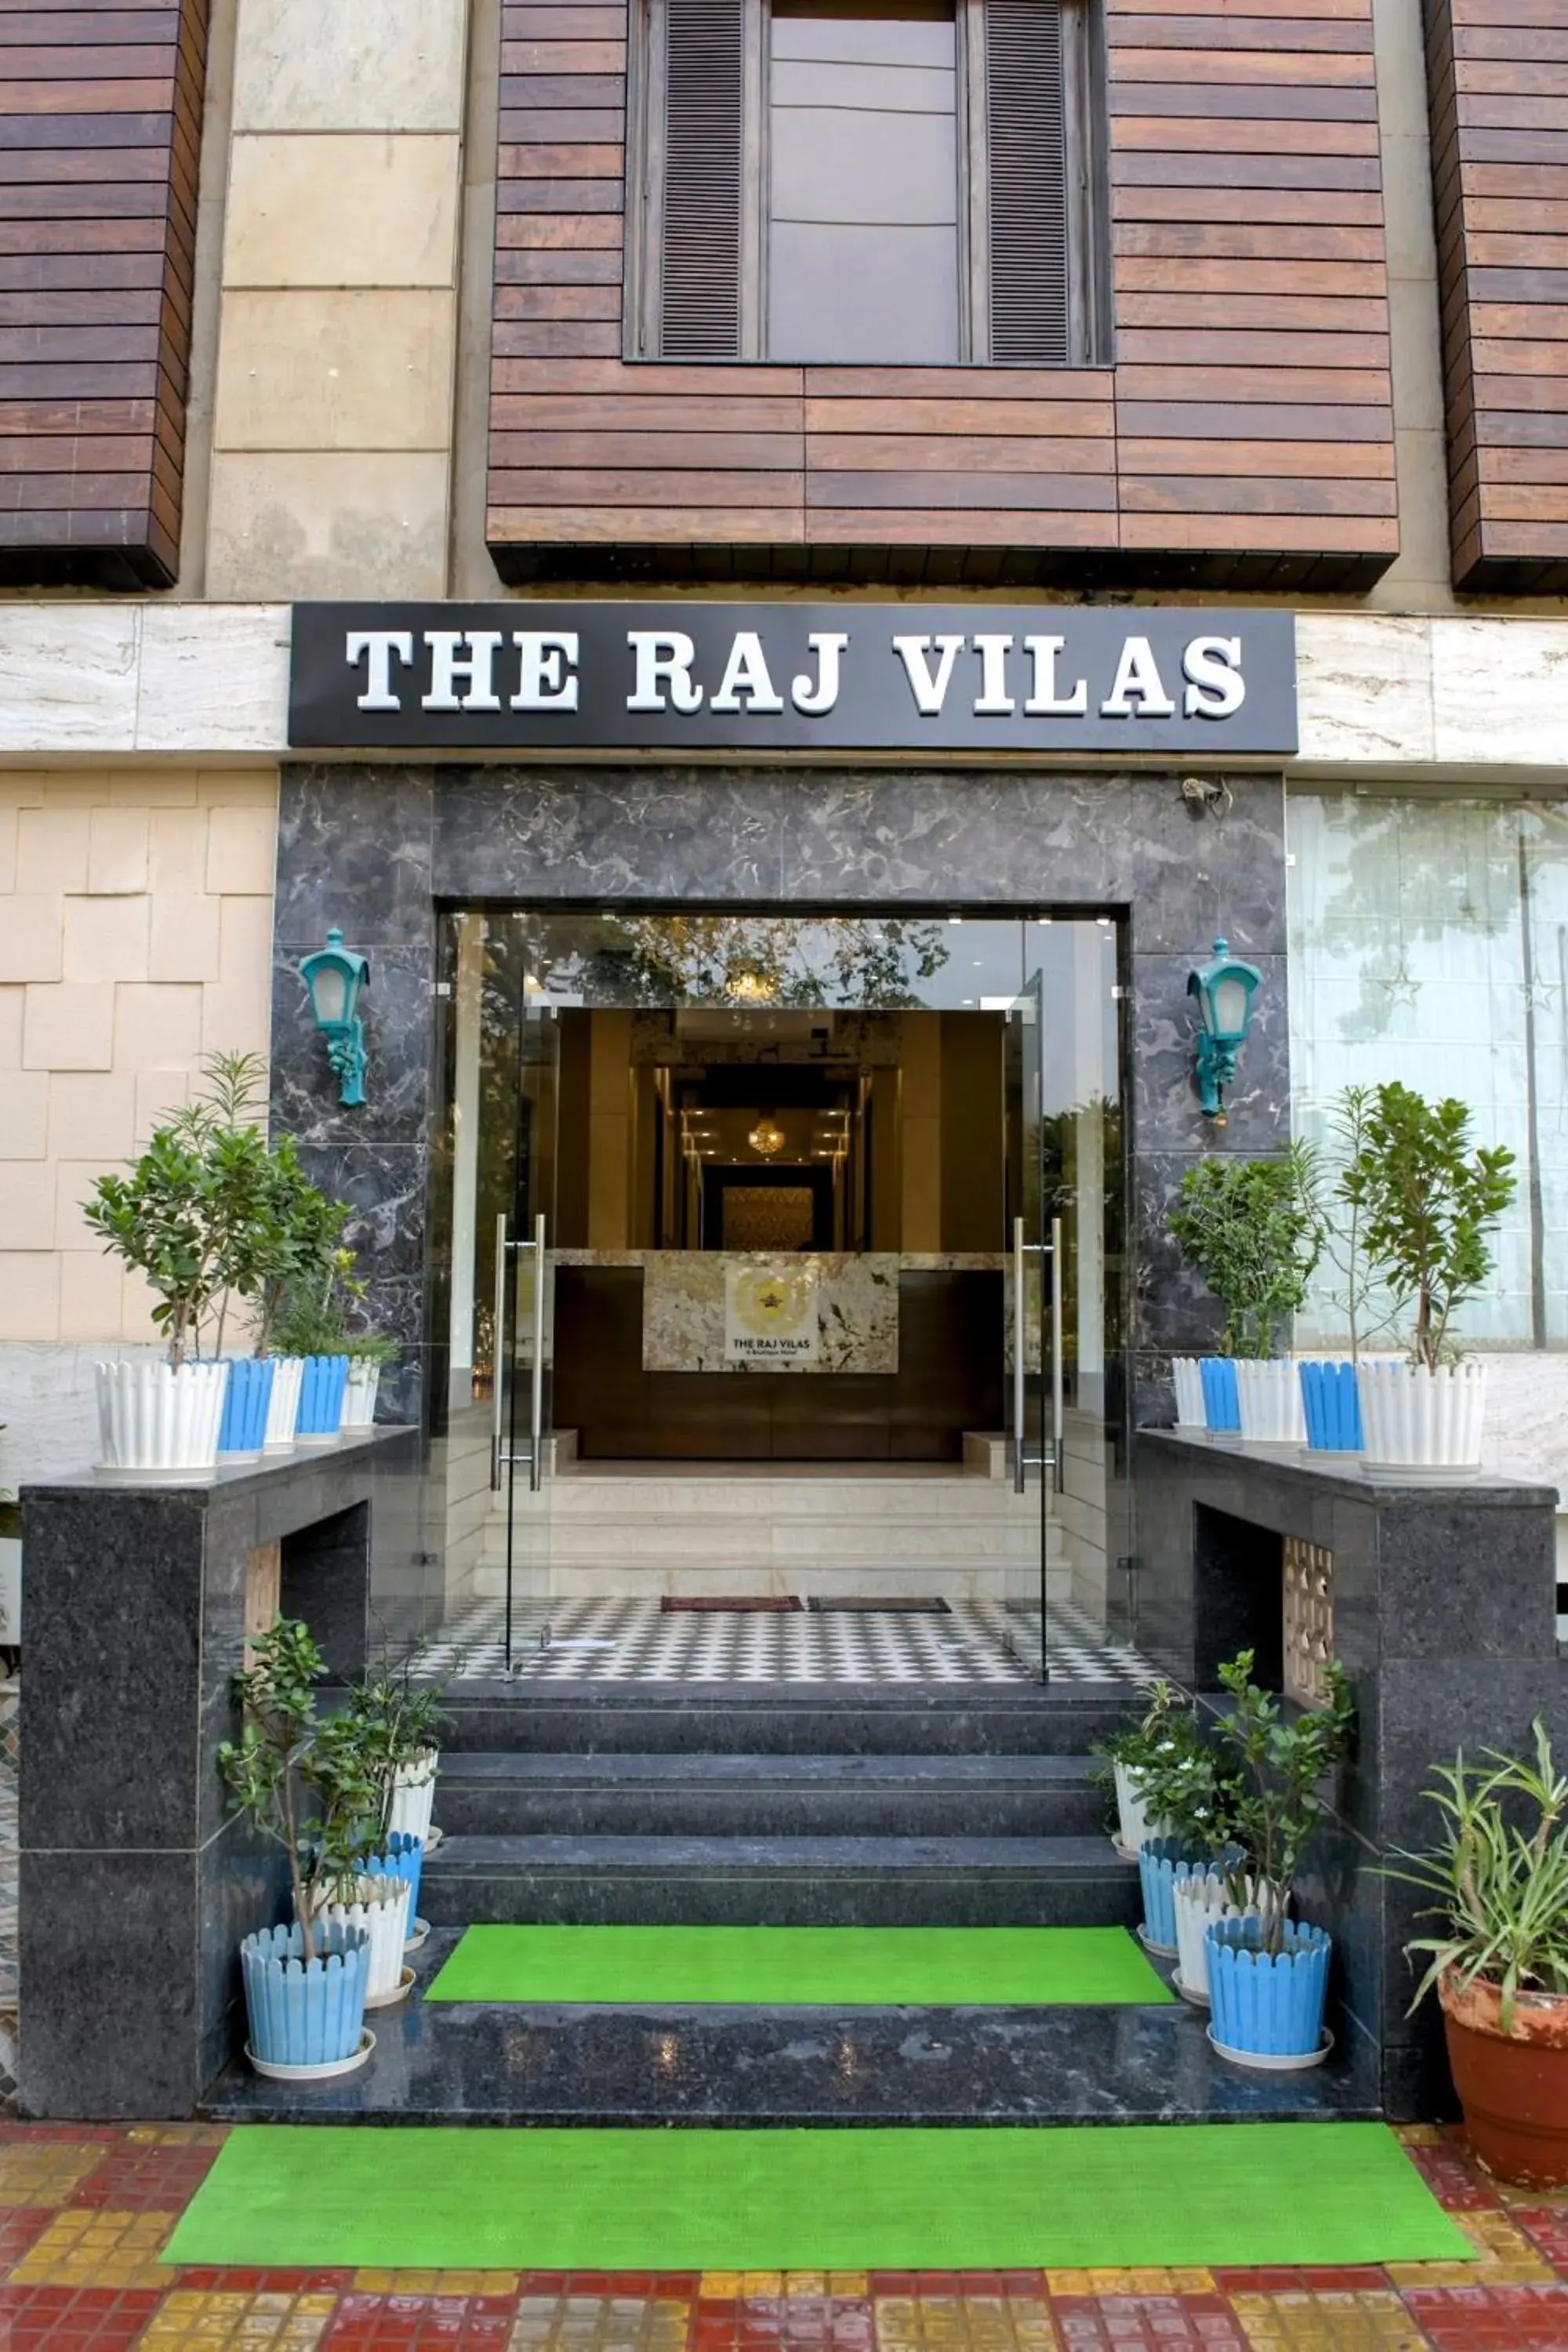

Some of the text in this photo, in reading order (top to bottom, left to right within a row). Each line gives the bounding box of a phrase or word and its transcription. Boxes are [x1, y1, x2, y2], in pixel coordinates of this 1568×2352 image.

[346, 630, 1247, 717] THE RAJ VILAS
[733, 1338, 810, 1349] THE RAJ VILAS
